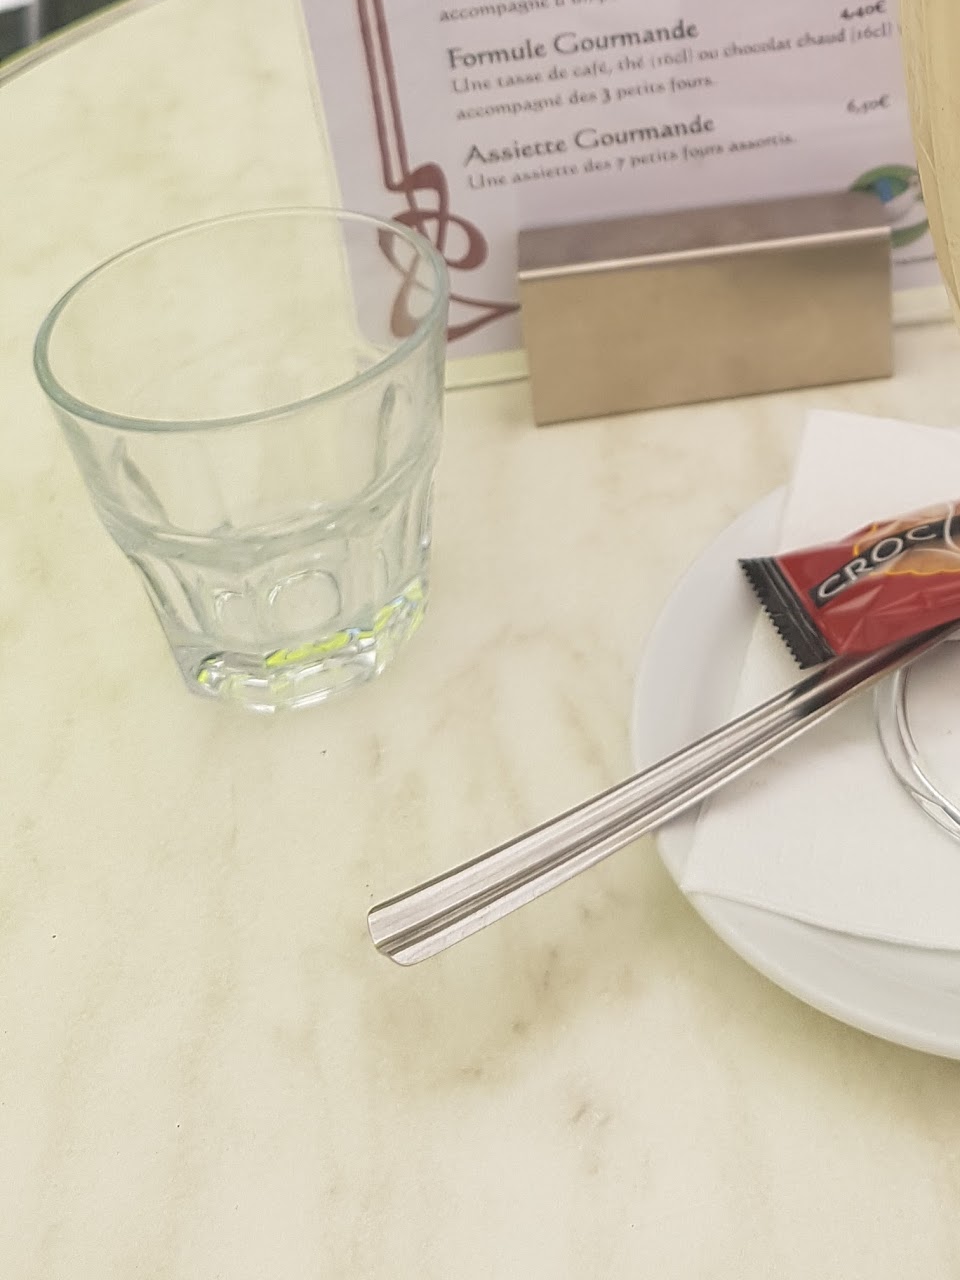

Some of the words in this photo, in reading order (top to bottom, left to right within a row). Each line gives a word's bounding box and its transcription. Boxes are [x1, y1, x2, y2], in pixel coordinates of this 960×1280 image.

[446, 37, 547, 70] Formule
[553, 20, 700, 56] Gourmande
[452, 78, 491, 95] Une
[497, 72, 542, 88] tasse
[549, 67, 568, 82] de
[573, 62, 613, 77] café,
[618, 55, 645, 71] thé
[699, 50, 719, 62] ou
[723, 37, 792, 59] chocolat
[797, 28, 847, 48] chaud
[456, 95, 562, 121] accompagné
[568, 89, 598, 106] des
[602, 87, 612, 105] 3
[617, 81, 666, 101] petits
[463, 139, 568, 168] Assiette
[574, 115, 715, 151] Gourmande
[468, 172, 506, 190] Une
[512, 162, 579, 184] assiette
[583, 157, 612, 173] des
[616, 157, 625, 171] 7
[630, 149, 679, 169] petits
[682, 143, 725, 162] fours
[816, 523, 933, 599] CROC
